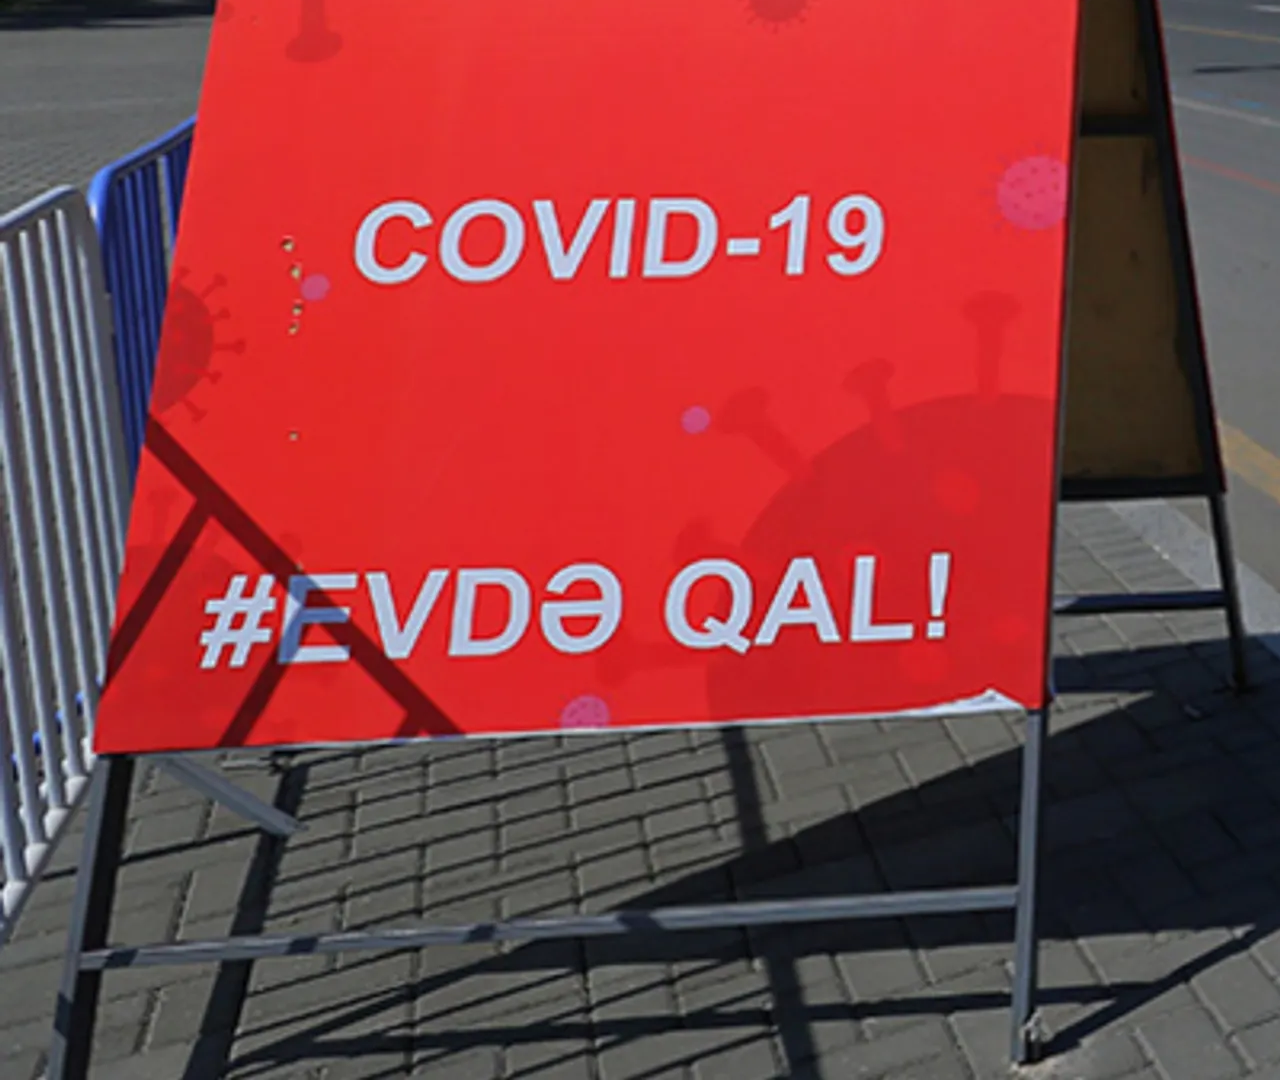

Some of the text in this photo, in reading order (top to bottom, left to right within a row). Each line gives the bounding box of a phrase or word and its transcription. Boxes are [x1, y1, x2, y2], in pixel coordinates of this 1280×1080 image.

[354, 194, 884, 284] COVID-19
[199, 552, 946, 669] #EVDƏ QAL!
